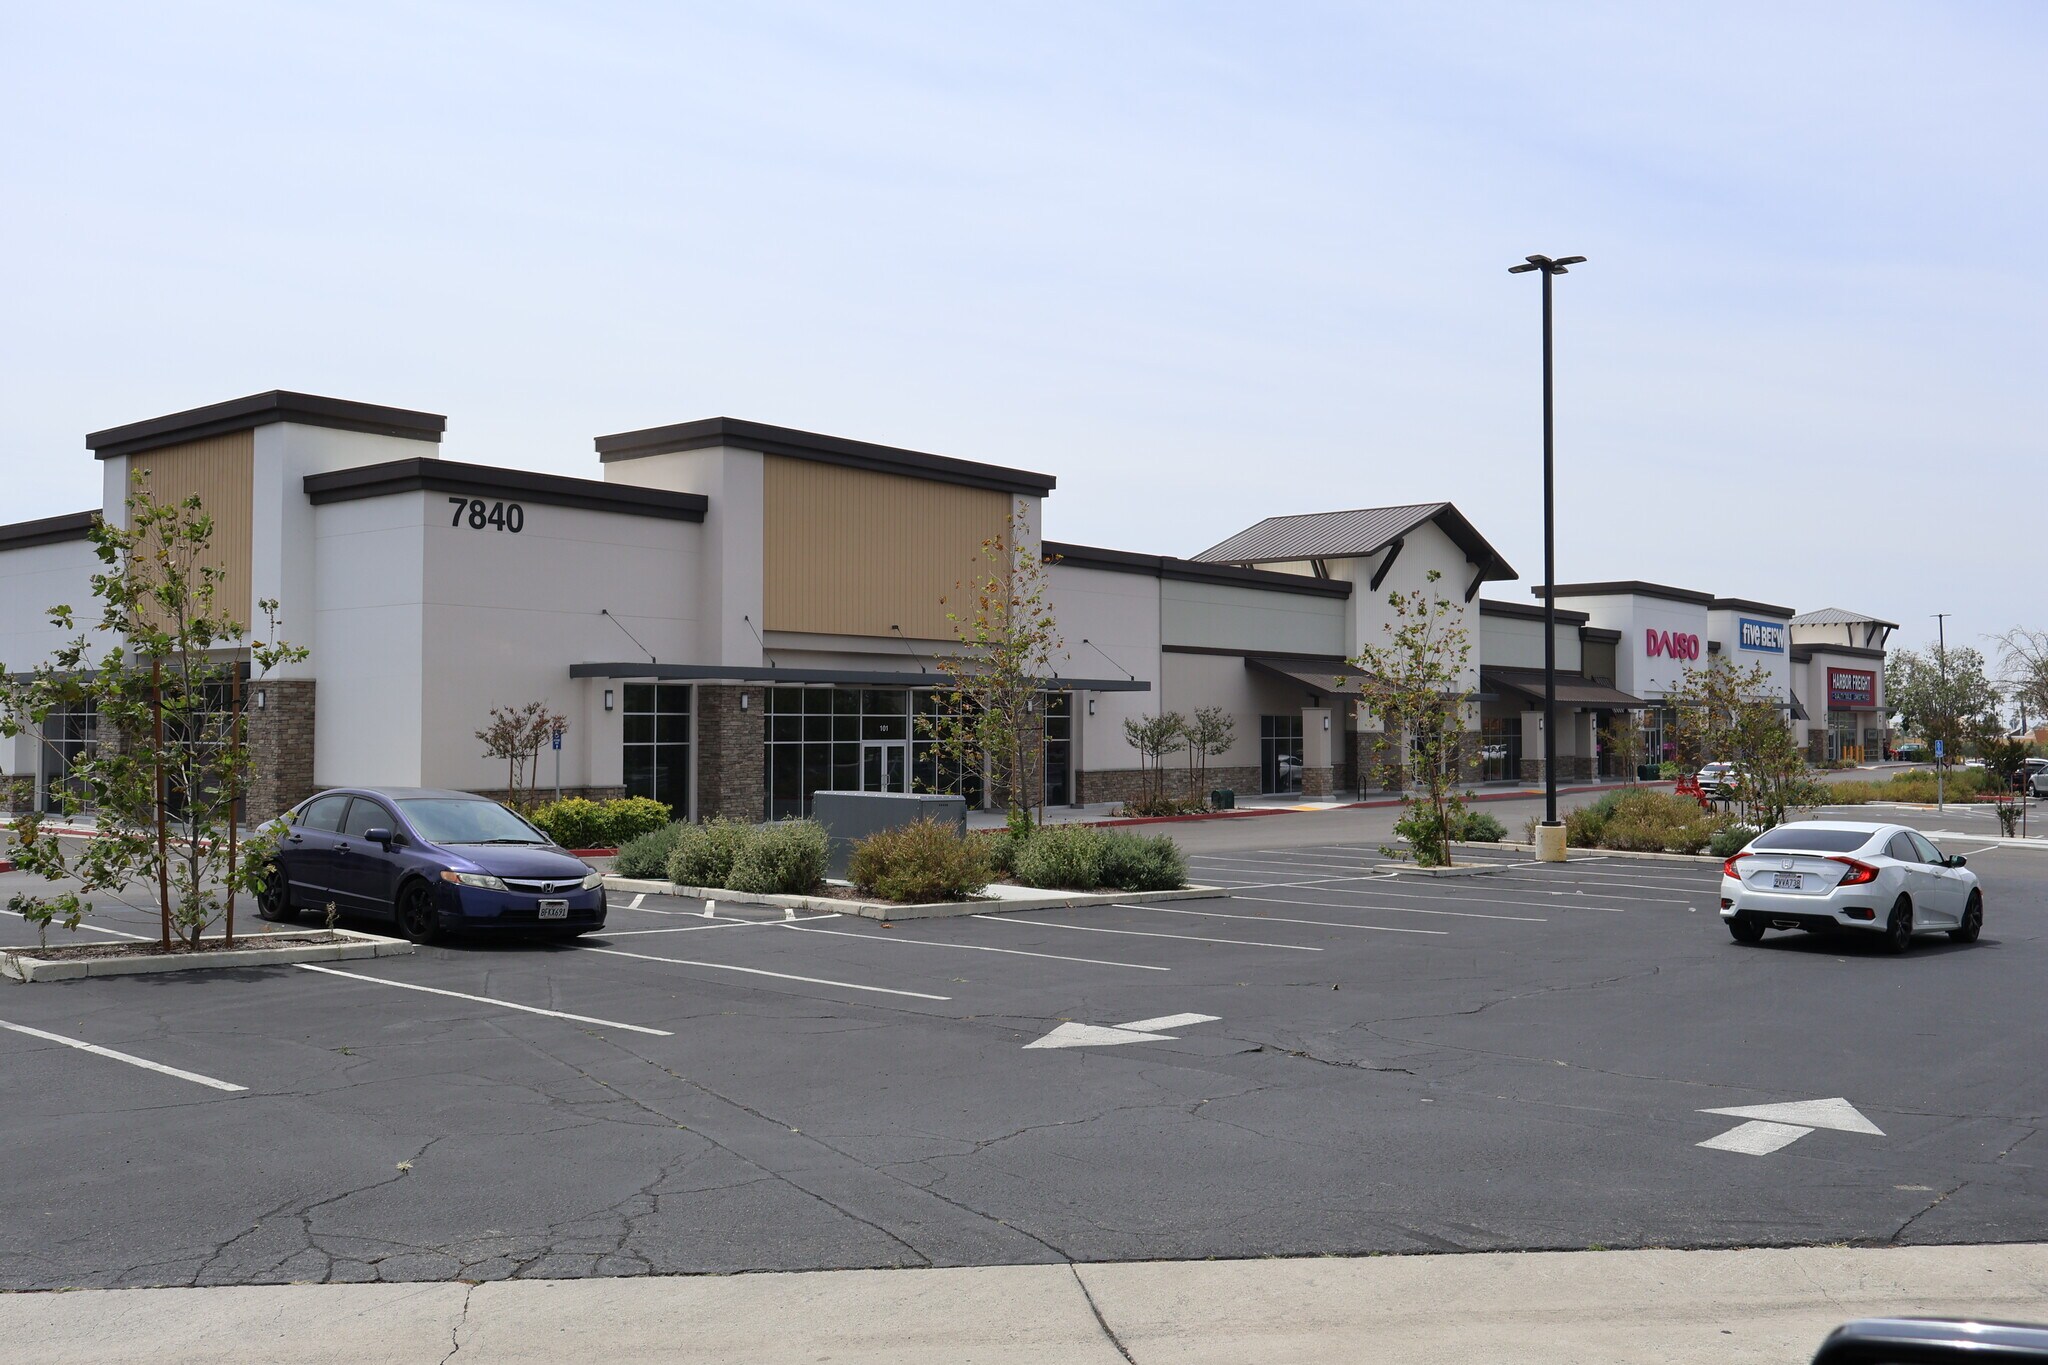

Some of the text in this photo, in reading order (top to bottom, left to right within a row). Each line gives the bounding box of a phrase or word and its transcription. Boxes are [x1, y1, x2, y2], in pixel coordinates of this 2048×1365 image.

[449, 497, 524, 533] 7840
[1646, 628, 1699, 660] DAISO
[1832, 673, 1870, 690] HARBOR FREIGHT
